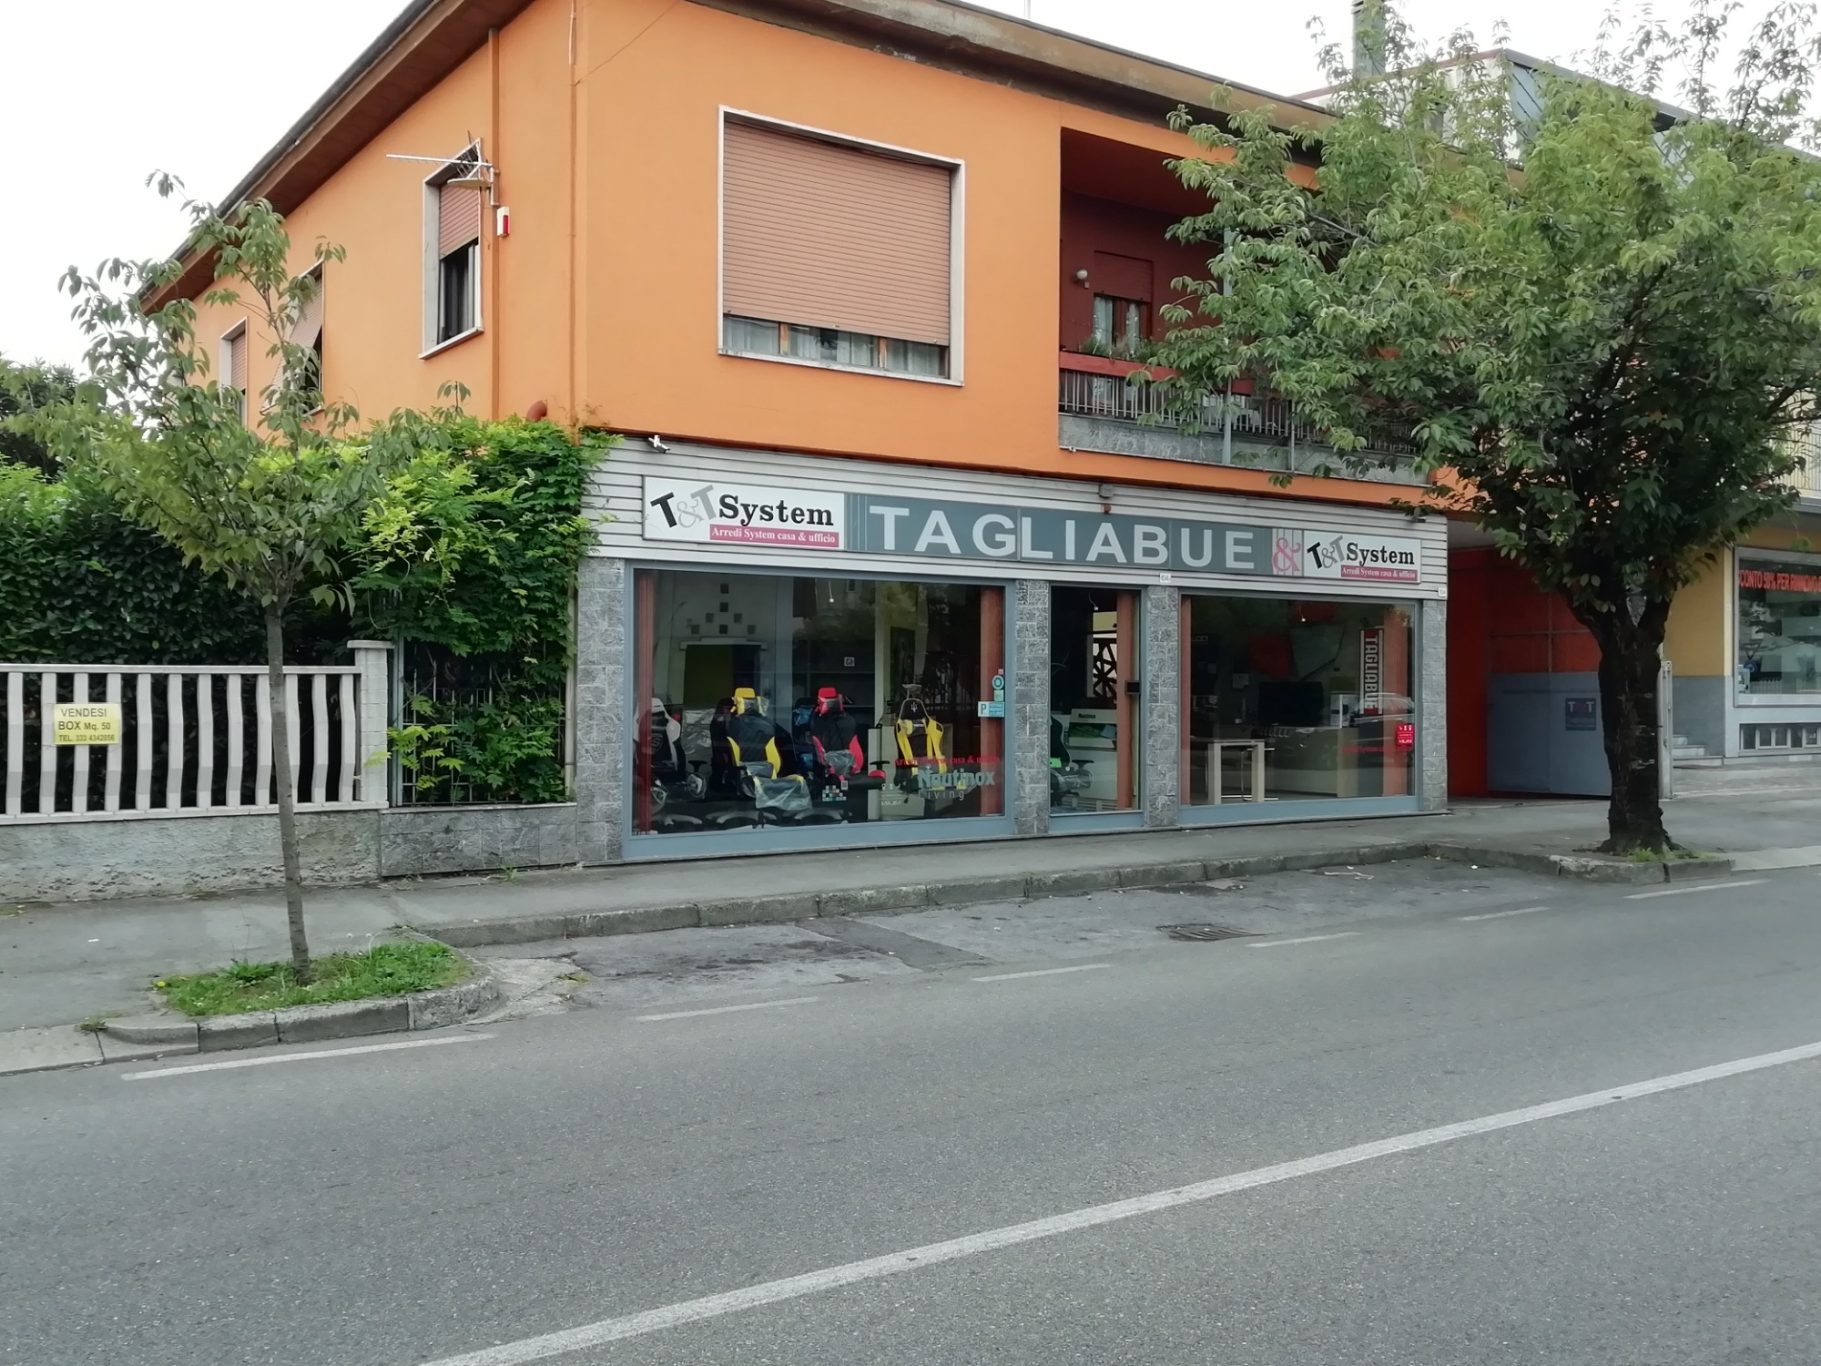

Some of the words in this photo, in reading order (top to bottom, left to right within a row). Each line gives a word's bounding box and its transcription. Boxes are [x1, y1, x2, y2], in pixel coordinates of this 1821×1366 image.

[650, 484, 717, 528] T&T
[719, 493, 834, 526] System
[711, 527, 743, 538] Arredi
[744, 528, 775, 541] System
[777, 532, 796, 541] casa
[797, 532, 807, 541] &
[808, 533, 835, 543] ufficio
[869, 505, 1255, 569] TAGLIABUE
[1346, 542, 1415, 566] System
[1360, 567, 1380, 577] System
[1364, 635, 1378, 708] TAGLIABUE
[60, 708, 107, 717] VENDESI
[58, 721, 81, 730] BOX
[101, 722, 111, 730] 50
